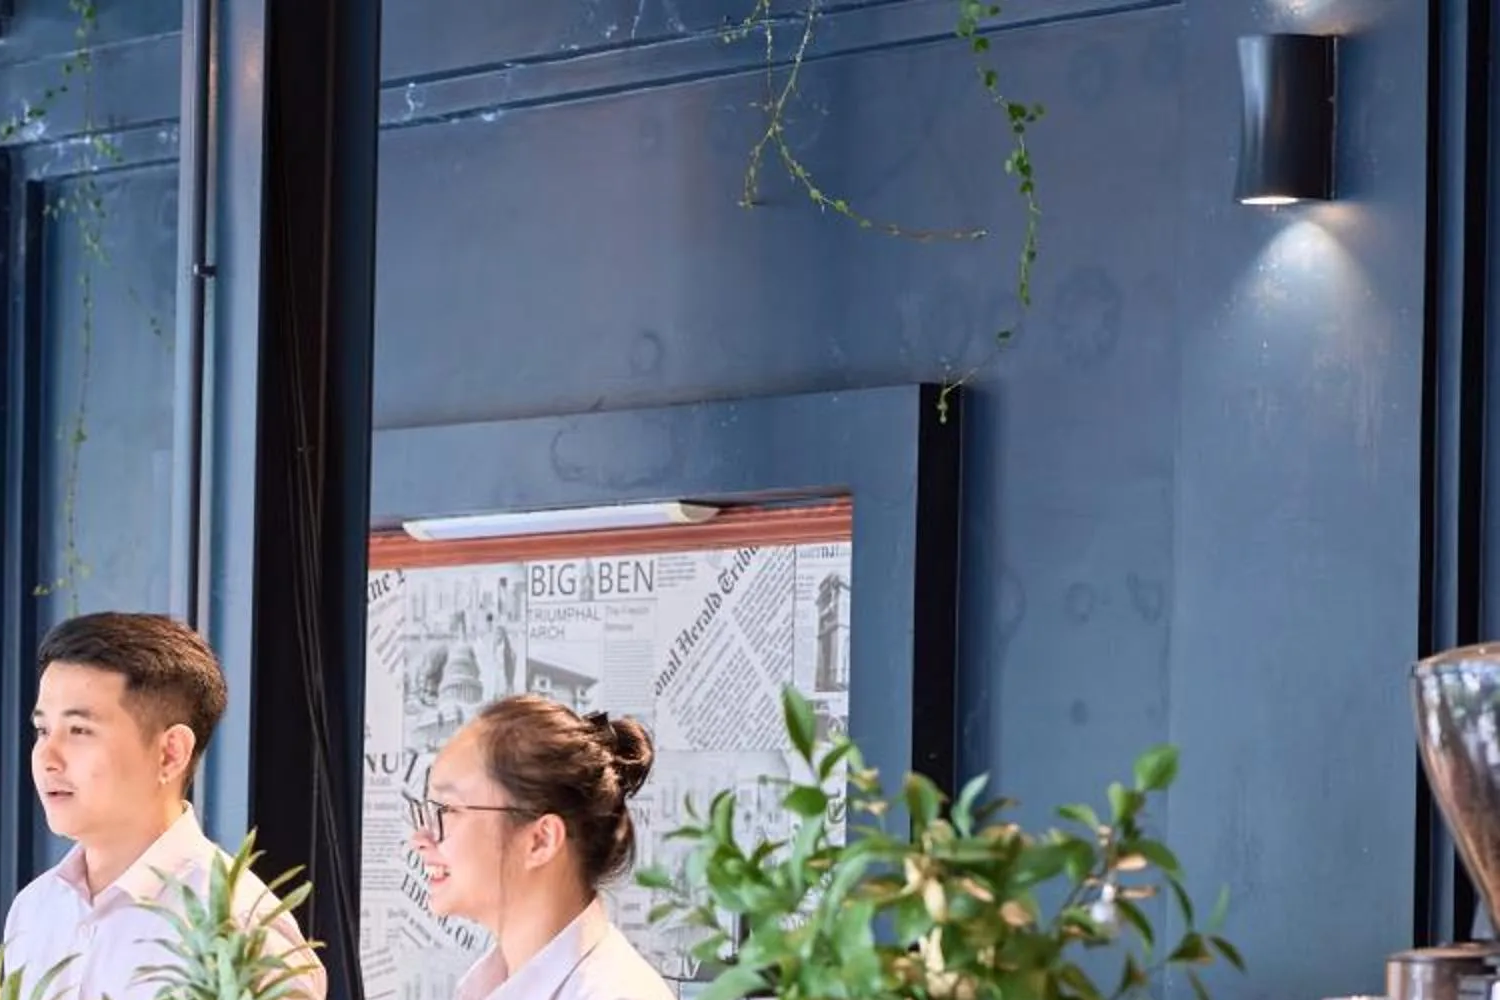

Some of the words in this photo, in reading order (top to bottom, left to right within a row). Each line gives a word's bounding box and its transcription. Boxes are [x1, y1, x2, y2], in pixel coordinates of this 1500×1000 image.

[531, 562, 576, 597] BIG
[598, 559, 655, 594] BEN
[527, 605, 602, 623] TRIUMPHAL
[674, 591, 723, 657] Herald
[529, 625, 565, 640] ARCH
